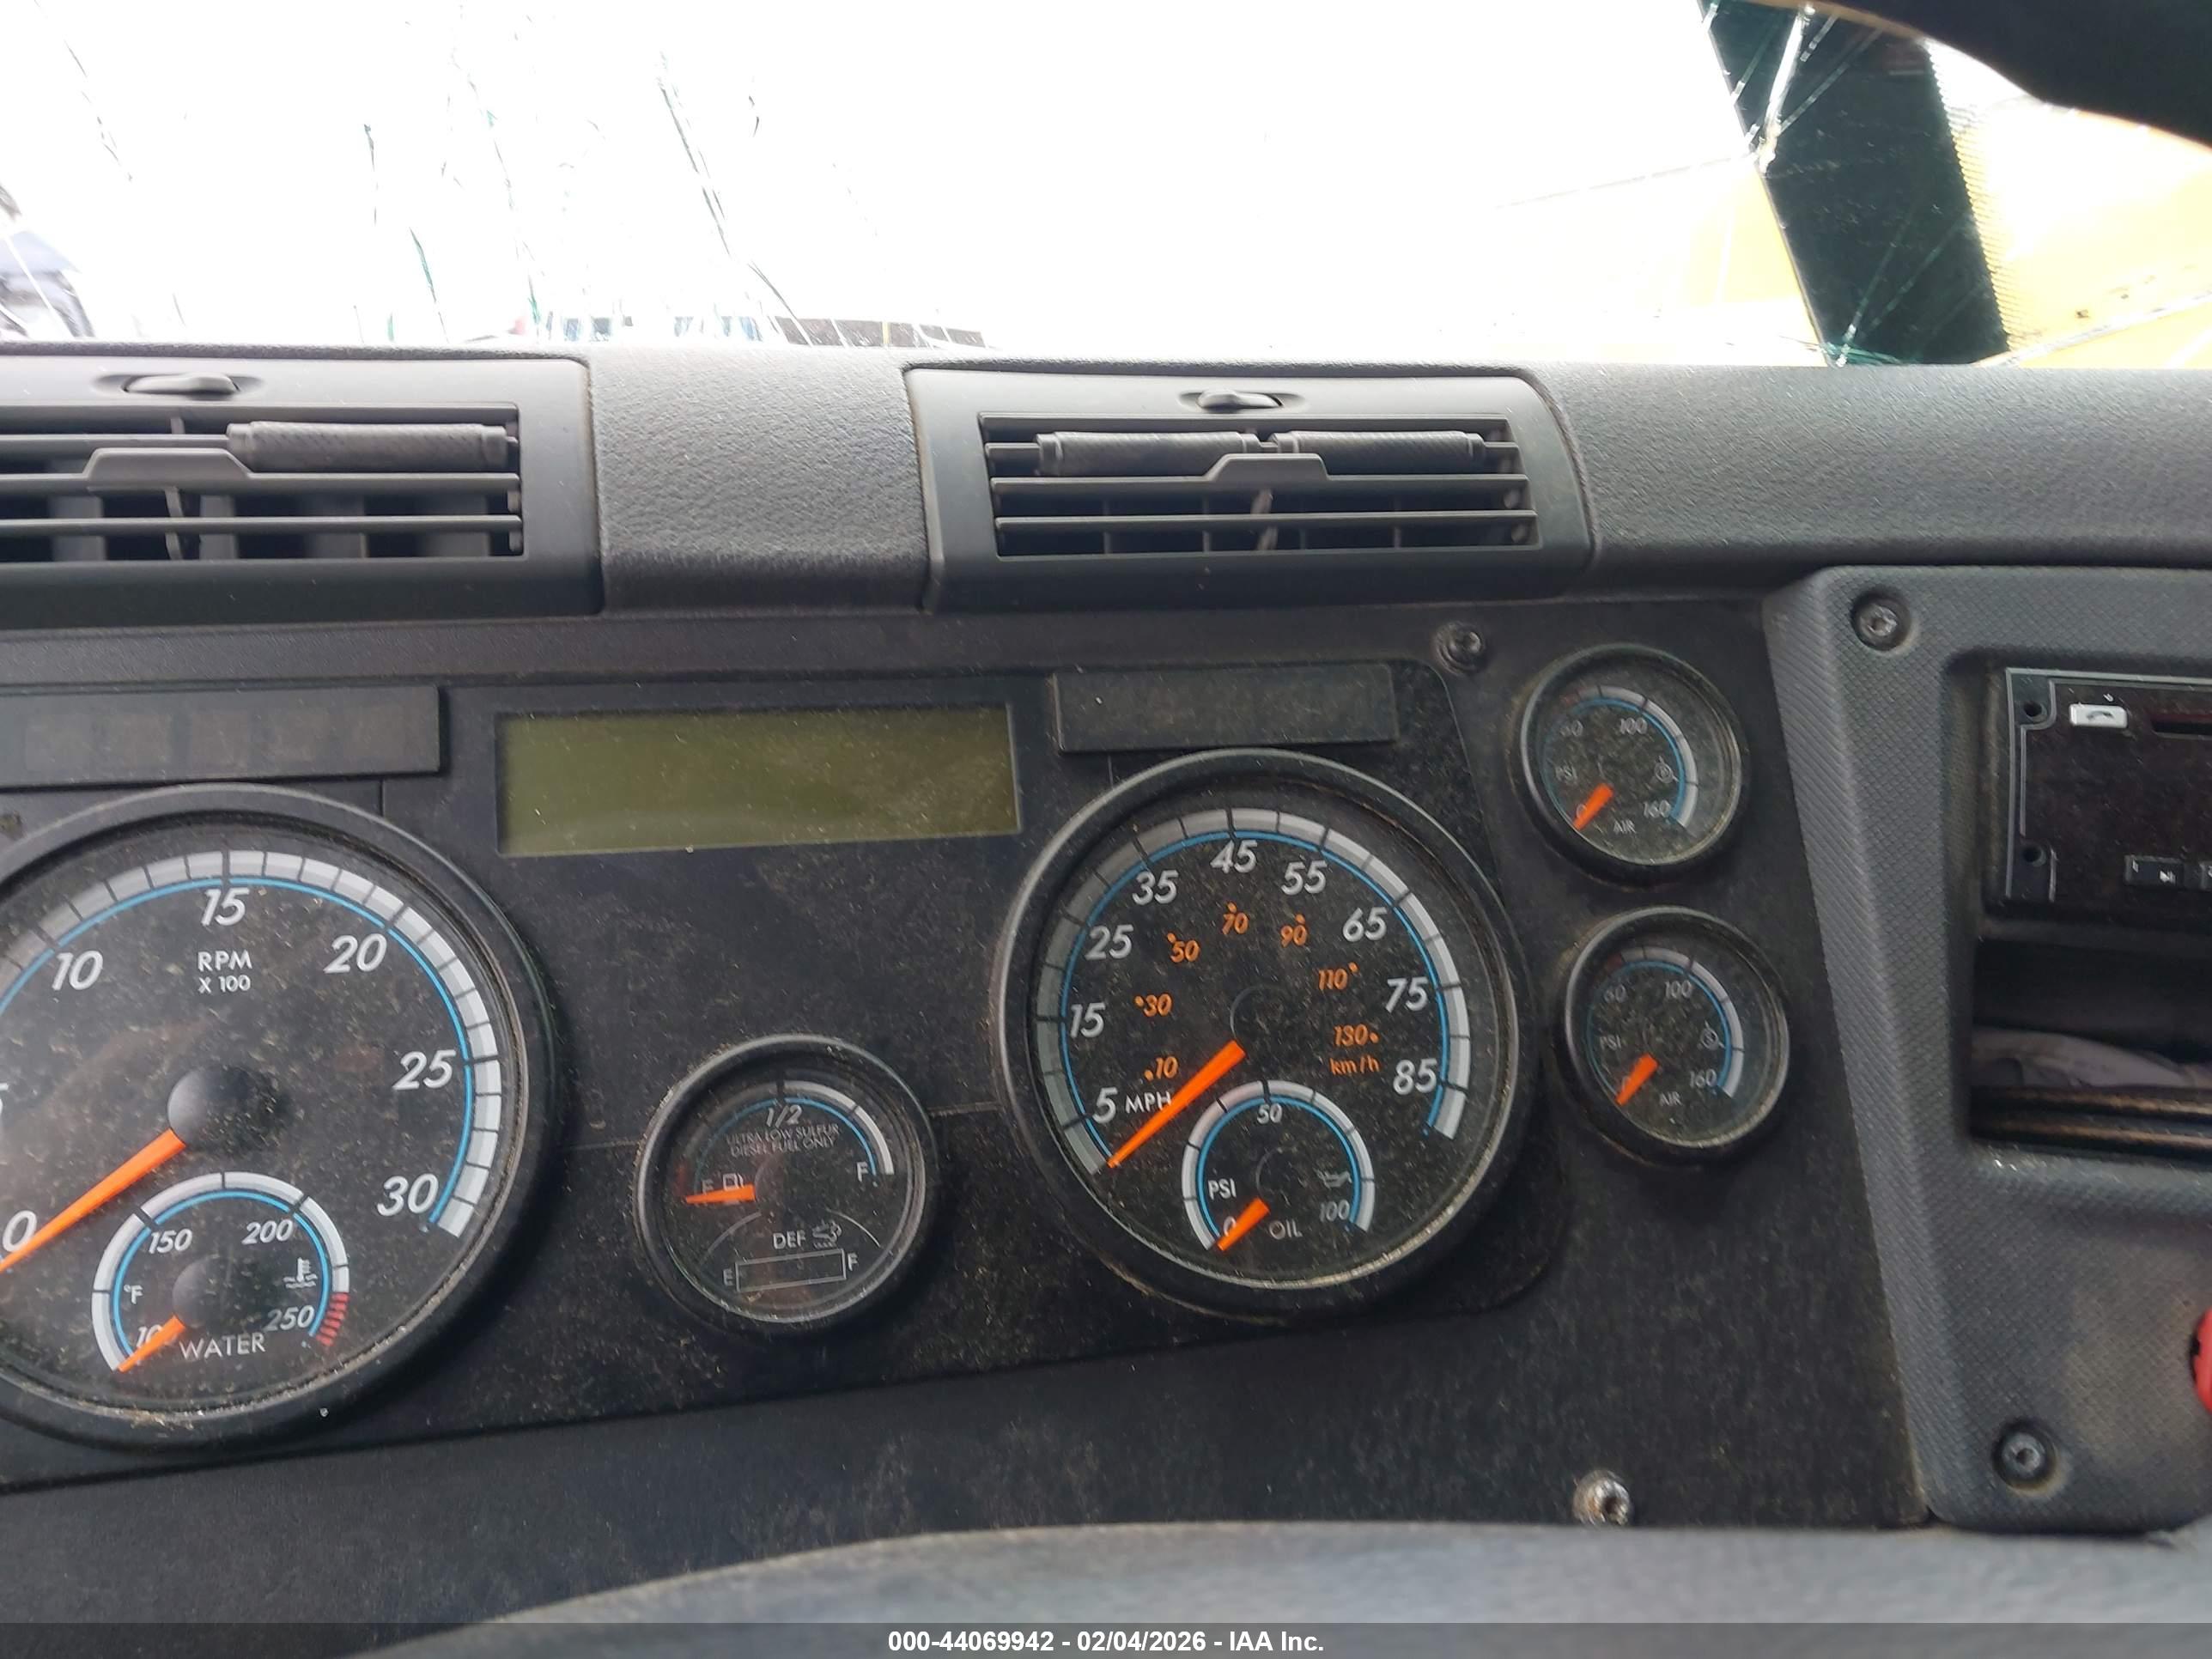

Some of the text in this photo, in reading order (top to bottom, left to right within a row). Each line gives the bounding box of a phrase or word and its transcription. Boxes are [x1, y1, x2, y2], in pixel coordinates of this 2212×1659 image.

[1210, 840, 1257, 873] 45
[1133, 870, 1178, 906] 35
[1281, 860, 1327, 895] 55
[198, 888, 248, 927] 15
[1222, 913, 1248, 935] 70
[1280, 924, 1308, 946] 90
[1342, 907, 1388, 942] 65
[324, 933, 386, 974] 20
[1085, 925, 1133, 961] 25
[1170, 940, 1200, 963] 50
[52, 951, 102, 990] 10
[198, 951, 252, 972] RPM
[218, 975, 251, 993] 100
[1319, 969, 1348, 990] 110
[1144, 994, 1171, 1017] 30
[1385, 976, 1429, 1013] 75
[1069, 1003, 1105, 1037] 15
[393, 1050, 456, 1090] 25
[1155, 1057, 1178, 1079] 10
[1329, 1054, 1380, 1075] km/h
[1393, 1059, 1437, 1095] 85
[1092, 1087, 1117, 1123] 5
[1125, 1092, 1171, 1114] MPH
[1256, 1104, 1282, 1124] 50
[766, 1105, 802, 1128] 1/2
[857, 1161, 868, 1182] F
[377, 1174, 439, 1216] 30
[1208, 1178, 1237, 1200] PSI
[1319, 1199, 1351, 1223] 100
[3, 1211, 37, 1253] 0
[149, 1229, 192, 1254] 150
[241, 1220, 293, 1245] 200
[774, 1231, 805, 1250] DEF
[1268, 1219, 1304, 1240] OIL
[266, 1307, 313, 1331] 250
[179, 1332, 265, 1360] WATER
